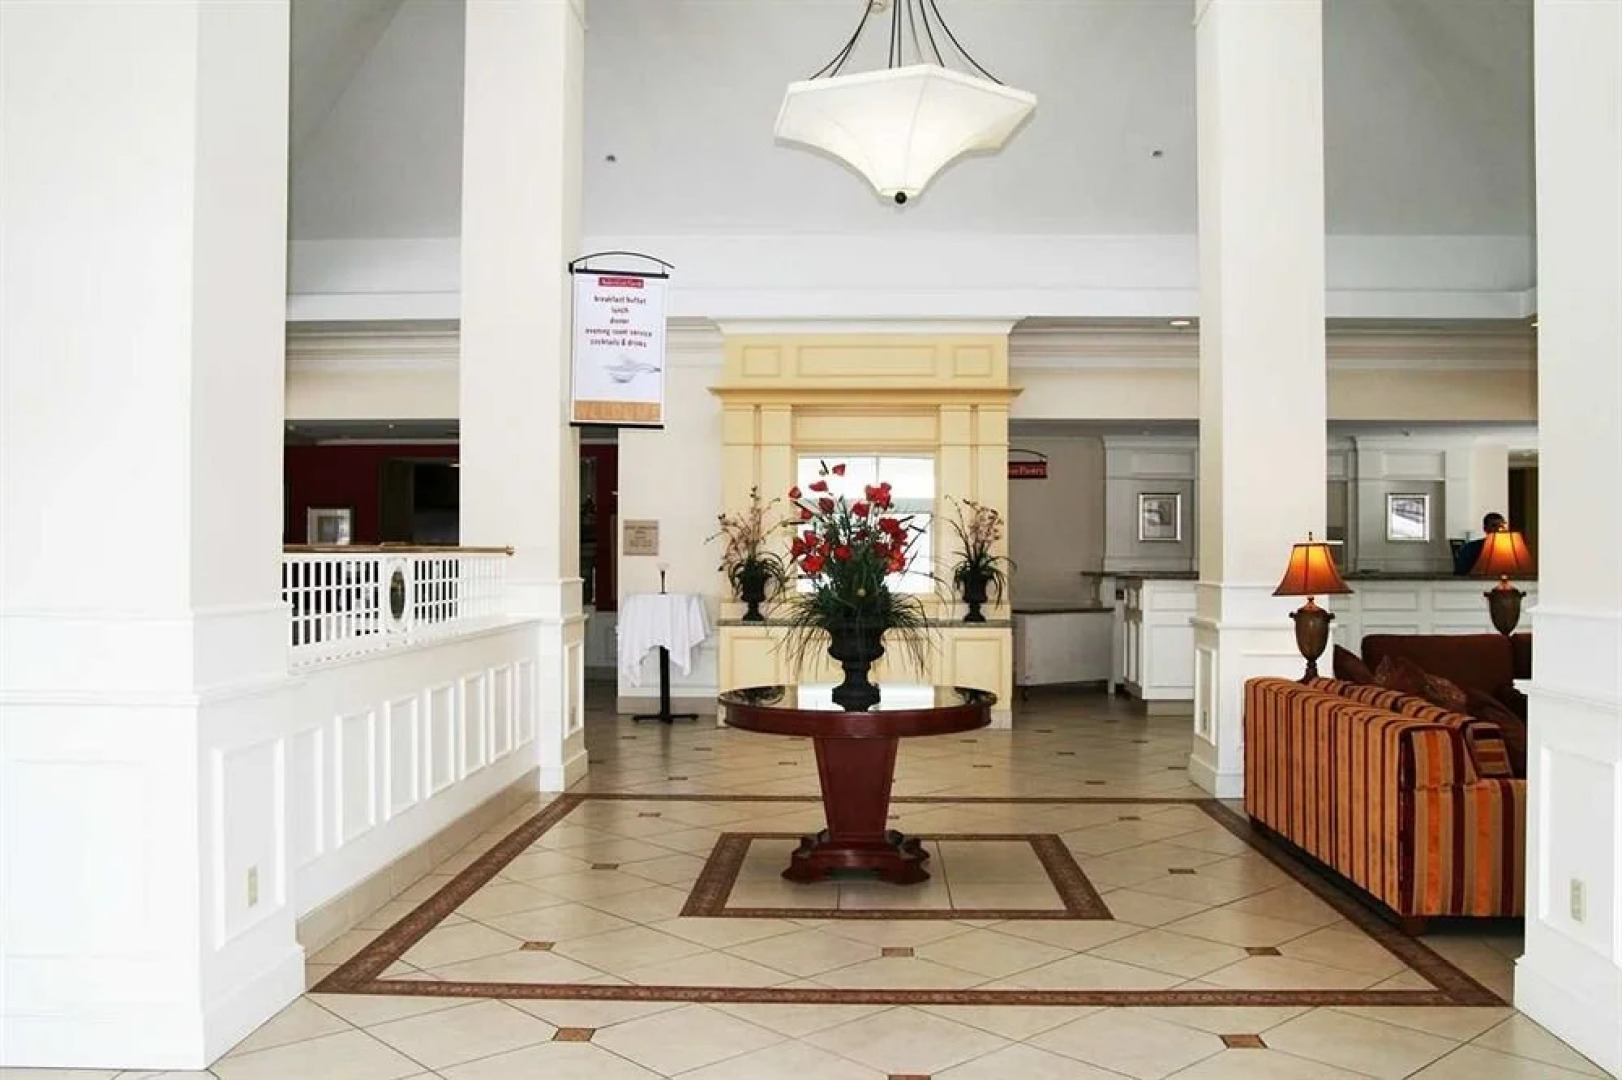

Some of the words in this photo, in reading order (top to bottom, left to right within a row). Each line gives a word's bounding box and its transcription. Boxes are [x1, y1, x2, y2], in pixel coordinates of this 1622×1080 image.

[594, 295, 625, 303] breakfast
[626, 297, 647, 305] buffet
[585, 328, 611, 336] evening
[590, 339, 620, 347] cocktails
[628, 340, 647, 349] drinks
